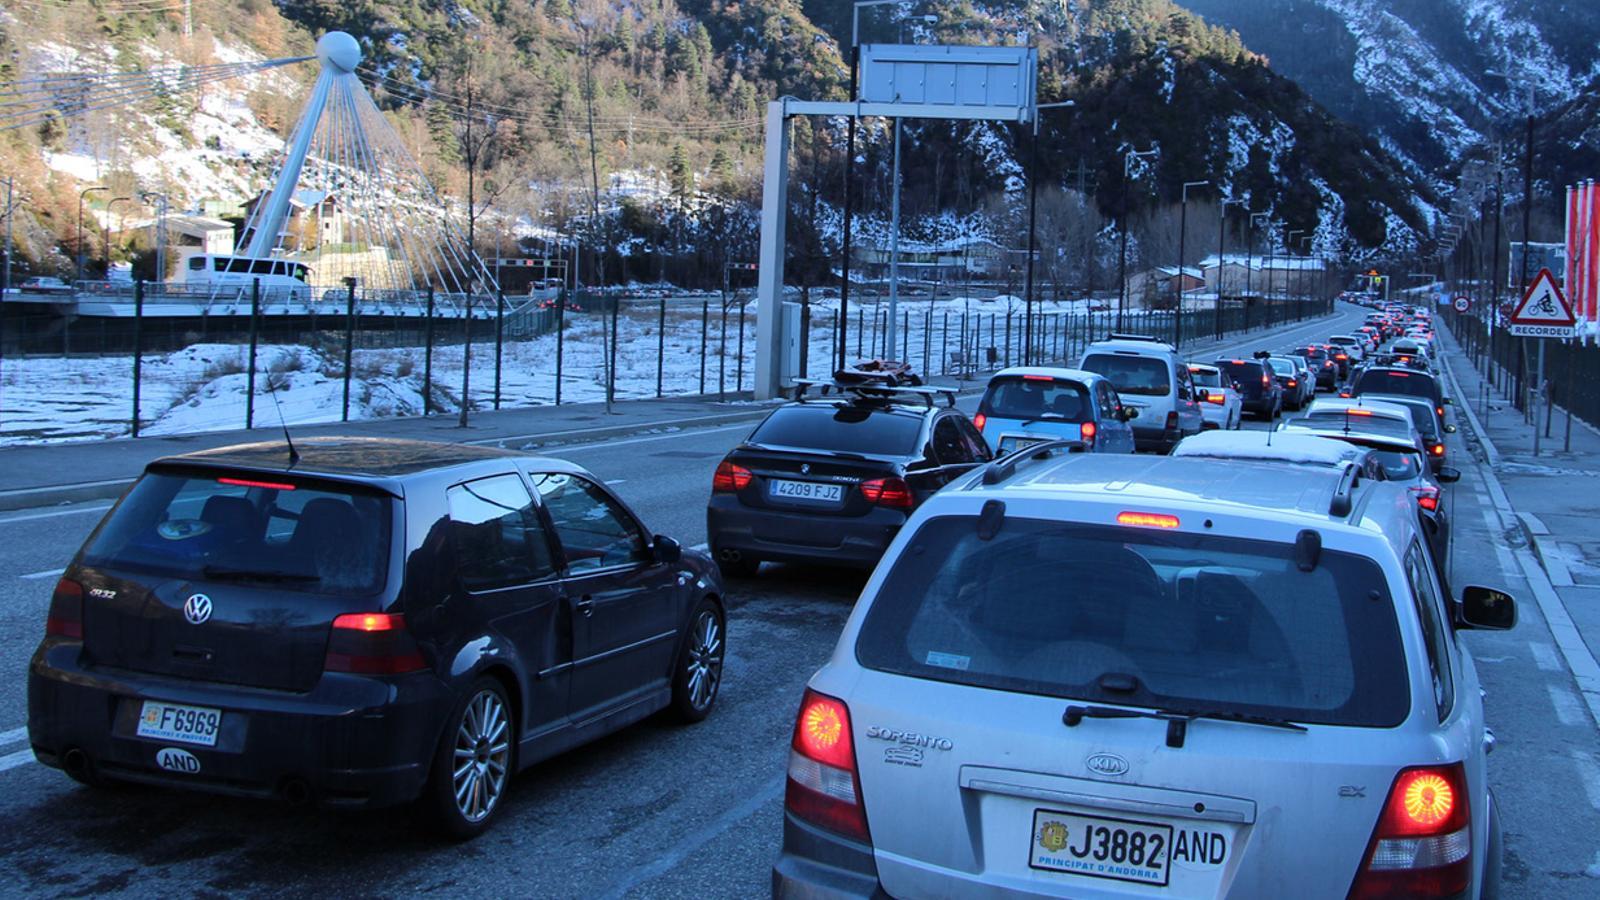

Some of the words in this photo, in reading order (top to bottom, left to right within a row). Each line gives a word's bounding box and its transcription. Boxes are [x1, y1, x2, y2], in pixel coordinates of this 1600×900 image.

[1515, 326, 1570, 336] RECORDEU
[779, 483, 811, 497] 4209
[814, 485, 839, 499] FJZ
[160, 707, 217, 735] F6969
[866, 726, 953, 751] SORENTO
[163, 752, 199, 772] AND
[1094, 758, 1122, 772] KIA
[1069, 825, 1165, 869] J3882
[1172, 830, 1226, 865] AND
[1038, 856, 1094, 871] PRINCIPAT
[1098, 864, 1159, 880] D'ANDORRA
